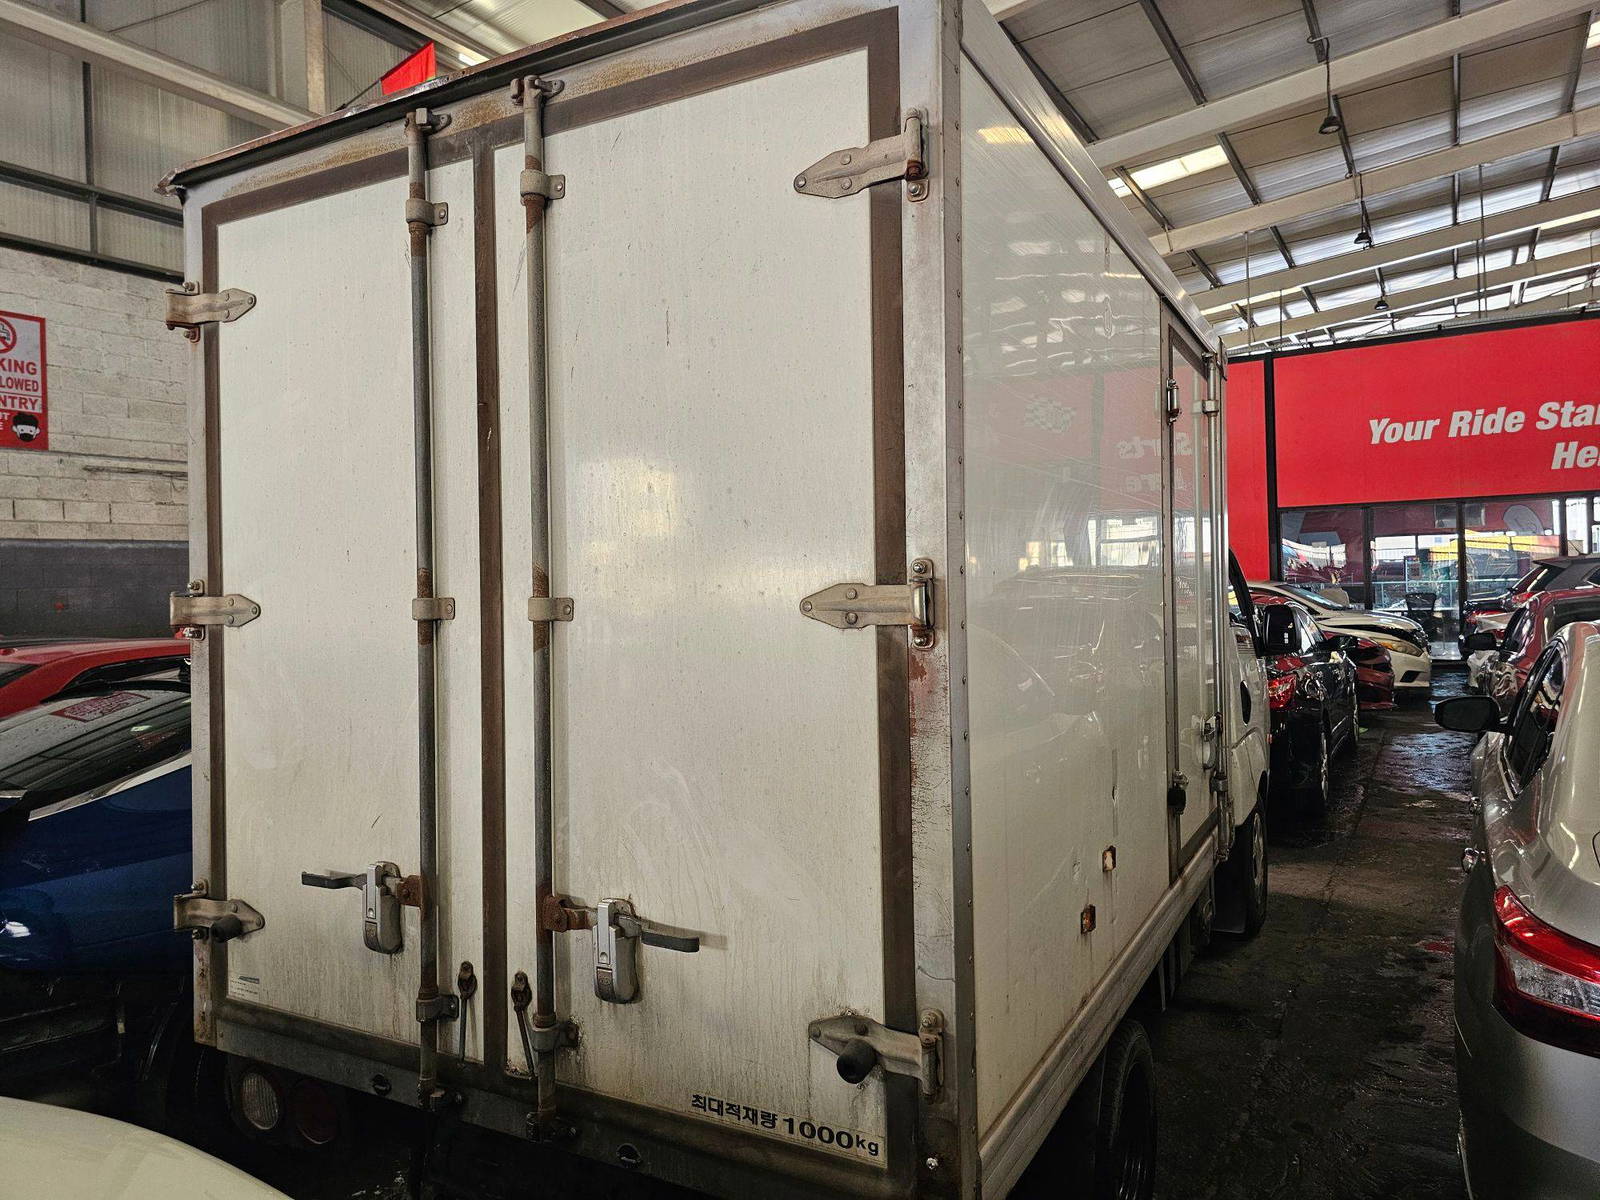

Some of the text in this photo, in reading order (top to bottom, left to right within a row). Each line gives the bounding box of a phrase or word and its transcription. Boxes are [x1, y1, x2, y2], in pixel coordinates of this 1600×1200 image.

[1369, 418, 1440, 444] Your
[1448, 407, 1525, 438] Ride
[1551, 441, 1600, 469] He
[692, 1094, 879, 1156] 최대적재량 1000kg
